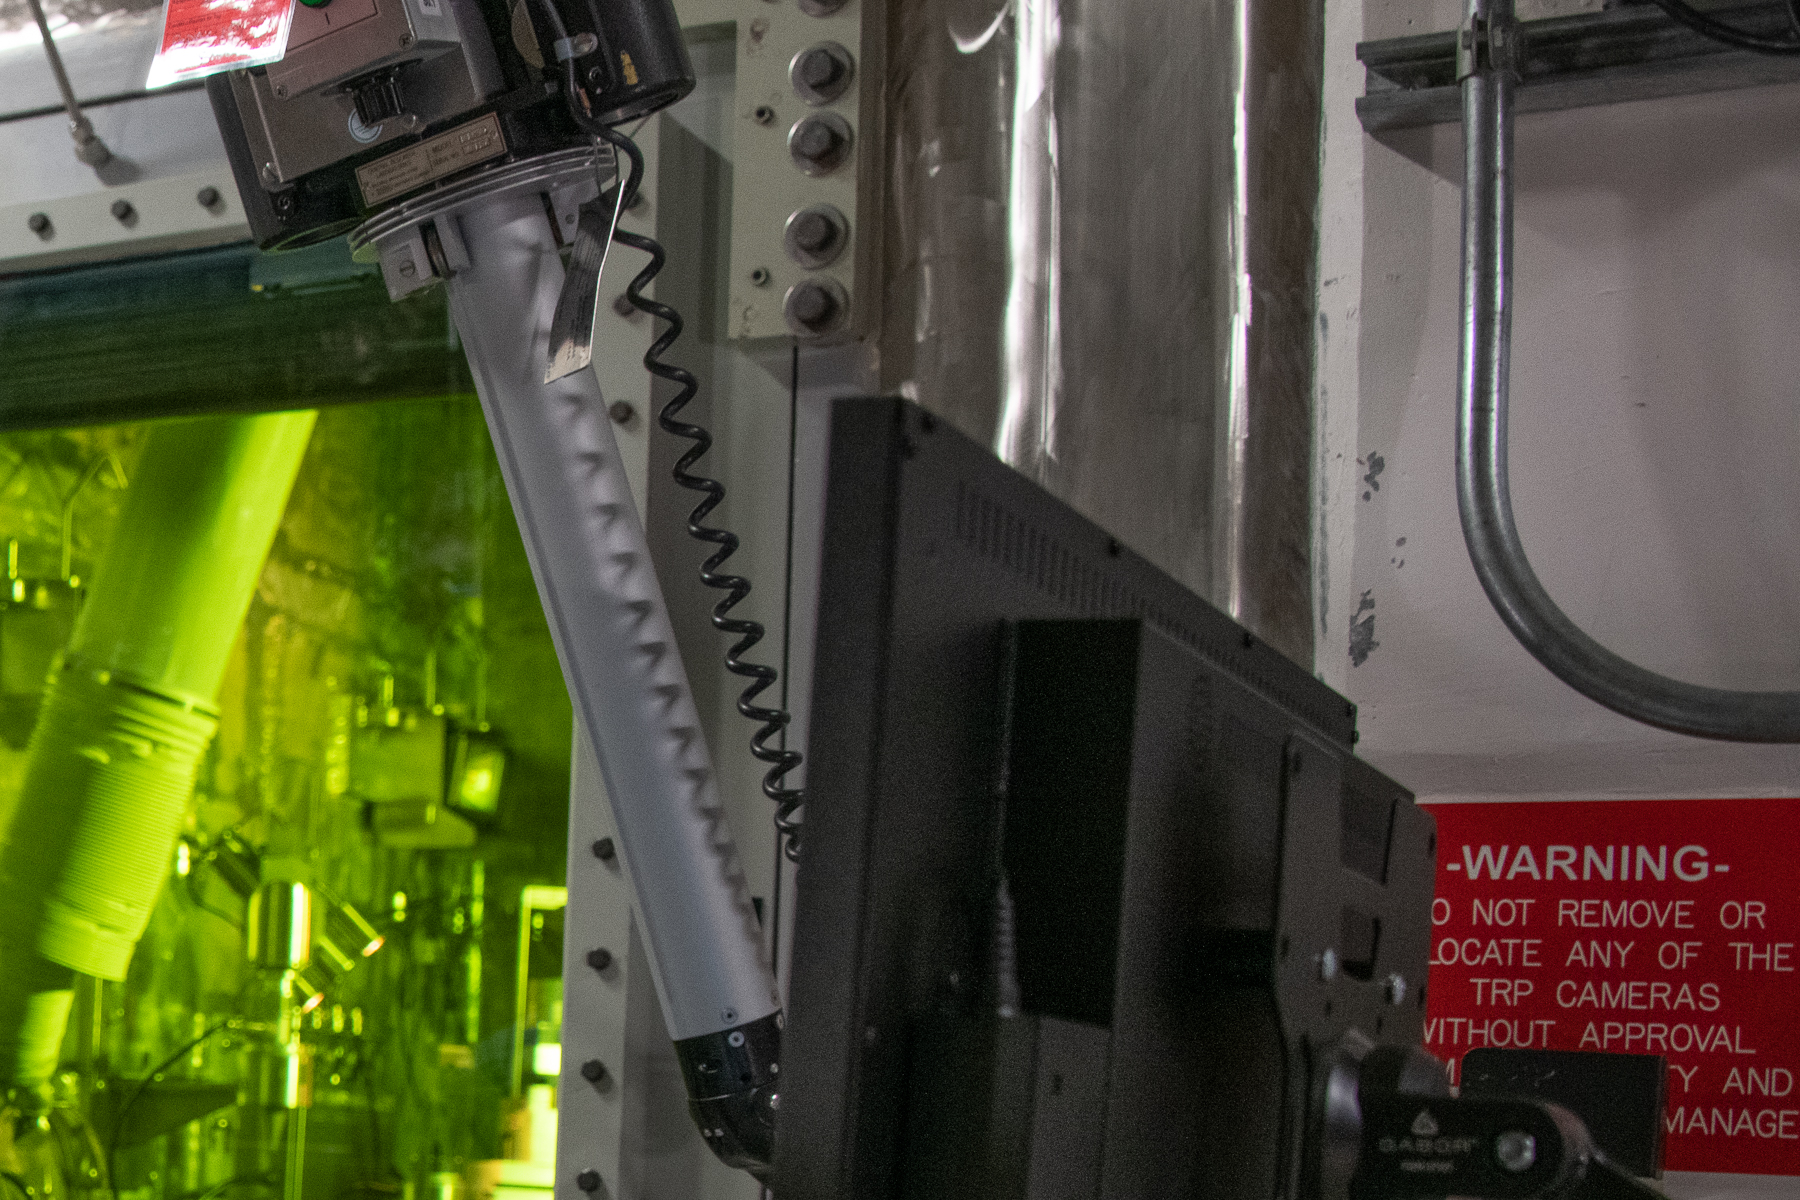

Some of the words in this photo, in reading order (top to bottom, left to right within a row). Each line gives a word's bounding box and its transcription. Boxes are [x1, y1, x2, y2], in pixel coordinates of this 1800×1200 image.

[1446, 844, 1731, 882] -WARNING-
[1430, 898, 1451, 927] O
[1472, 898, 1536, 927] NOT
[1558, 899, 1695, 929] REMOVE
[1719, 900, 1766, 929] OR
[1428, 937, 1543, 967] OCATE
[1565, 939, 1635, 969] ANY
[1658, 940, 1703, 970] OF
[1728, 941, 1795, 972] THE
[1469, 978, 1534, 1007] TRP
[1556, 980, 1721, 1012] CAMERAS
[1579, 1022, 1757, 1055] APPROVAL
[1721, 1066, 1793, 1097] AND
